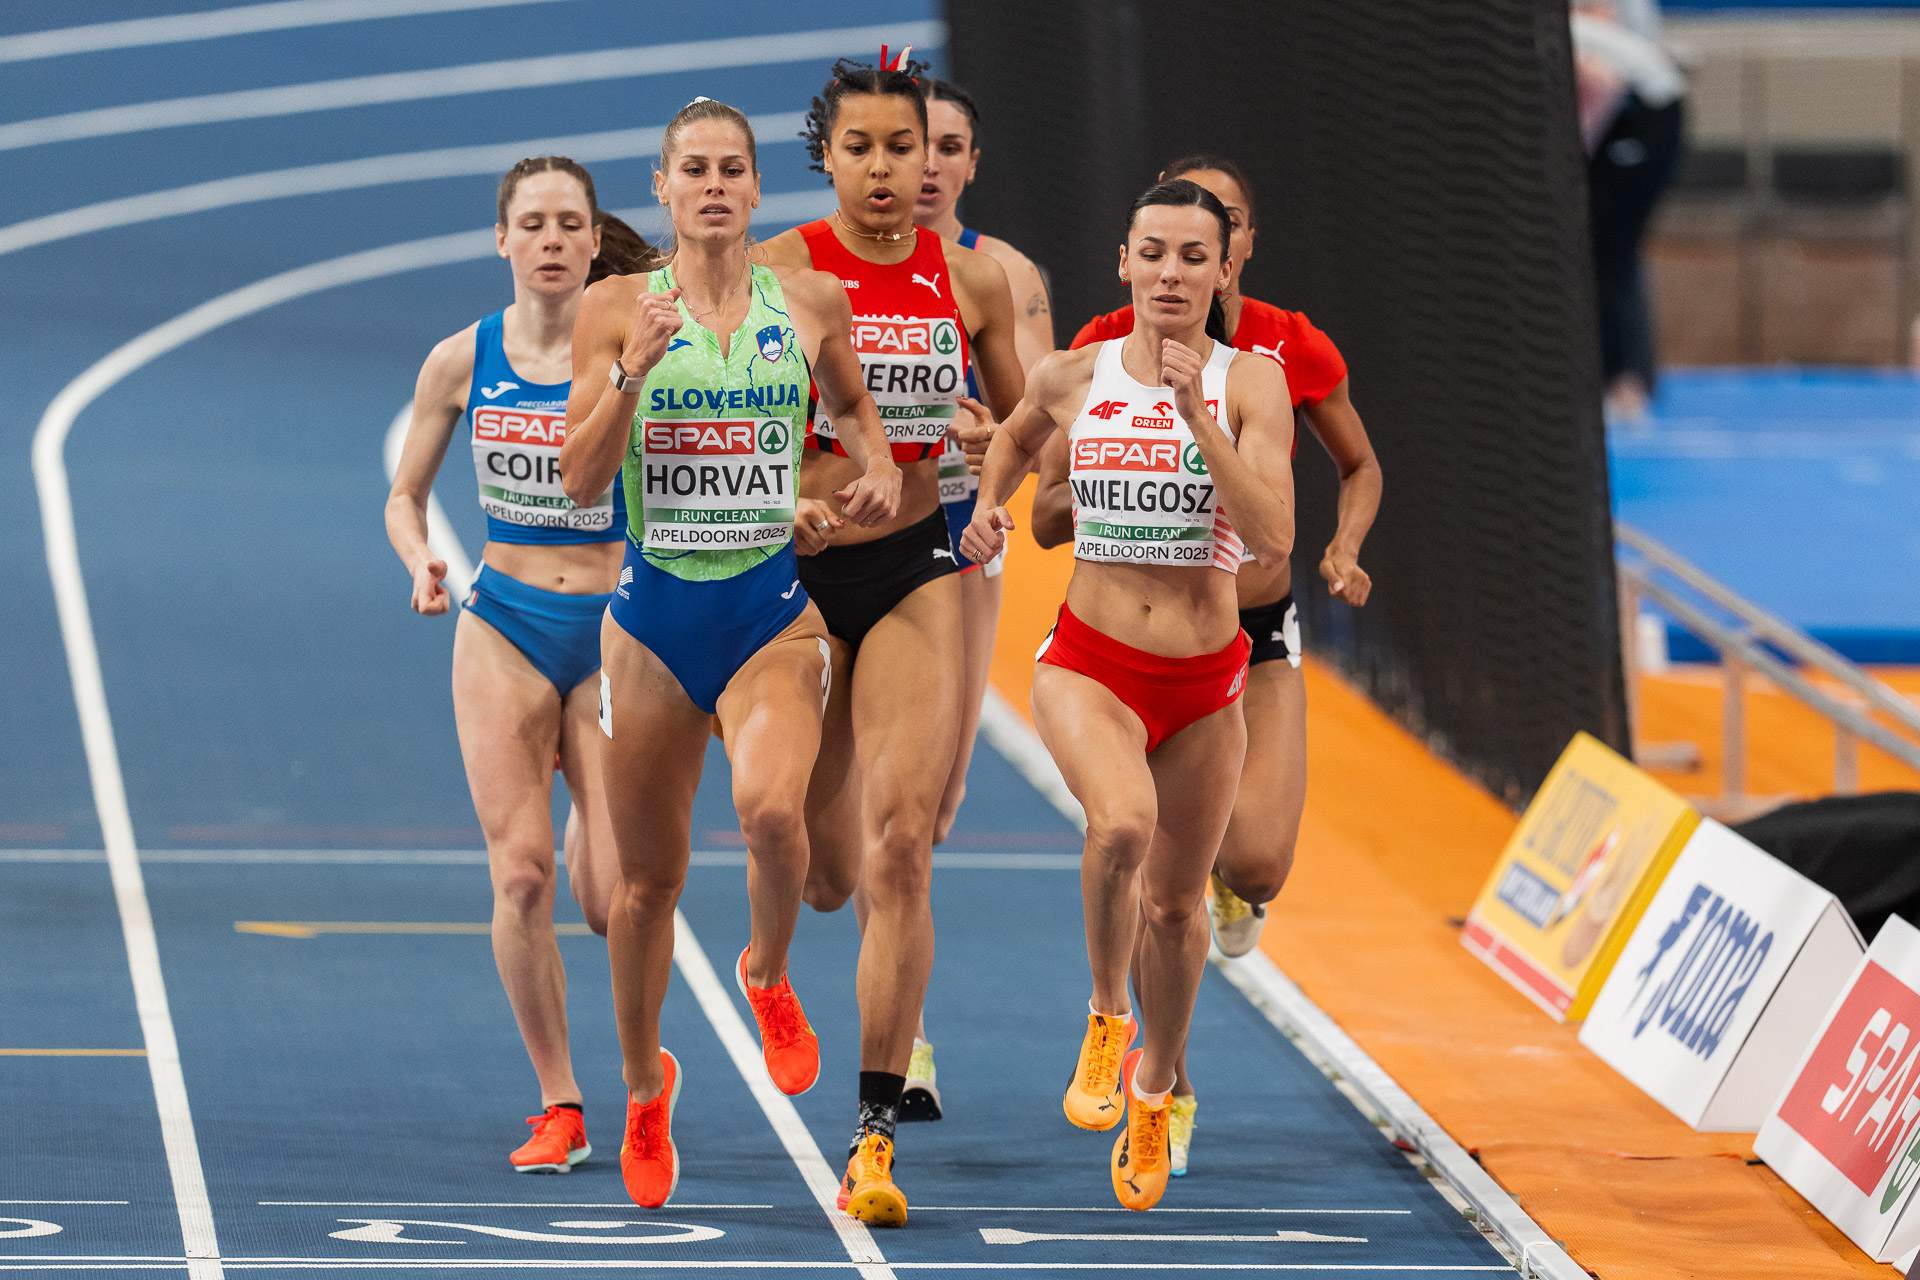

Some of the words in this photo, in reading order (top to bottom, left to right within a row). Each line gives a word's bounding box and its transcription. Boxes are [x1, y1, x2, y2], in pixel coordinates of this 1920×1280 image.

[841, 280, 860, 289] UBS
[651, 384, 801, 411] SLOVENIJA
[1089, 400, 1129, 419] 4F
[1133, 418, 1171, 428] ORLEN
[647, 426, 752, 450] SPAR
[1077, 442, 1178, 467] SPAR
[646, 464, 788, 496] HORVAT
[938, 482, 966, 498] 025
[1071, 479, 1214, 514] WIELGOSZ
[485, 503, 569, 528] APELDOORN
[573, 512, 608, 527] 2025
[674, 511, 679, 522] I
[681, 511, 712, 521] RUN
[651, 528, 750, 543] APELDOORN
[753, 526, 788, 541] 2025
[1104, 525, 1131, 538] RUN
[1078, 541, 1169, 560] APELDOORN
[1174, 547, 1210, 560] 2025
